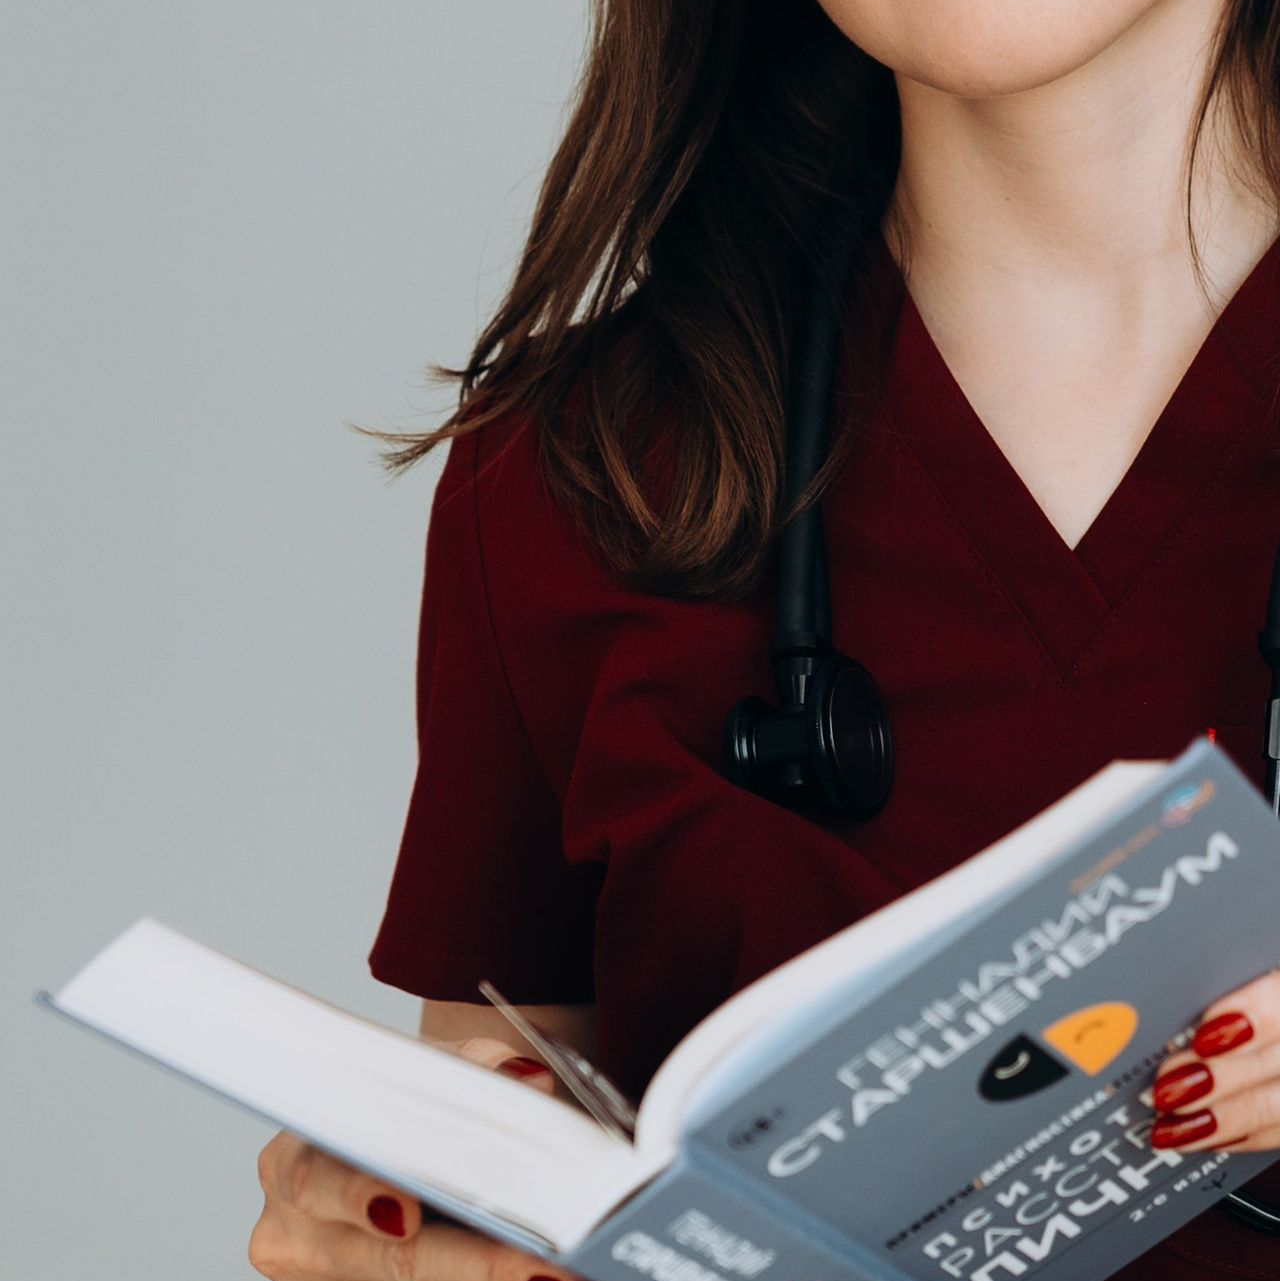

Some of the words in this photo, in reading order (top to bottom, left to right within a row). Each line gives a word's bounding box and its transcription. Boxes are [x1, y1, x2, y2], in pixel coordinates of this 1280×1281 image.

[768, 832, 1238, 1178] СТАРШЕНБАУМ
[837, 874, 1129, 1089] ГЕННАДИЙ
[1129, 1193, 1168, 1222] 2-е
[1173, 1151, 1230, 1193] изда
